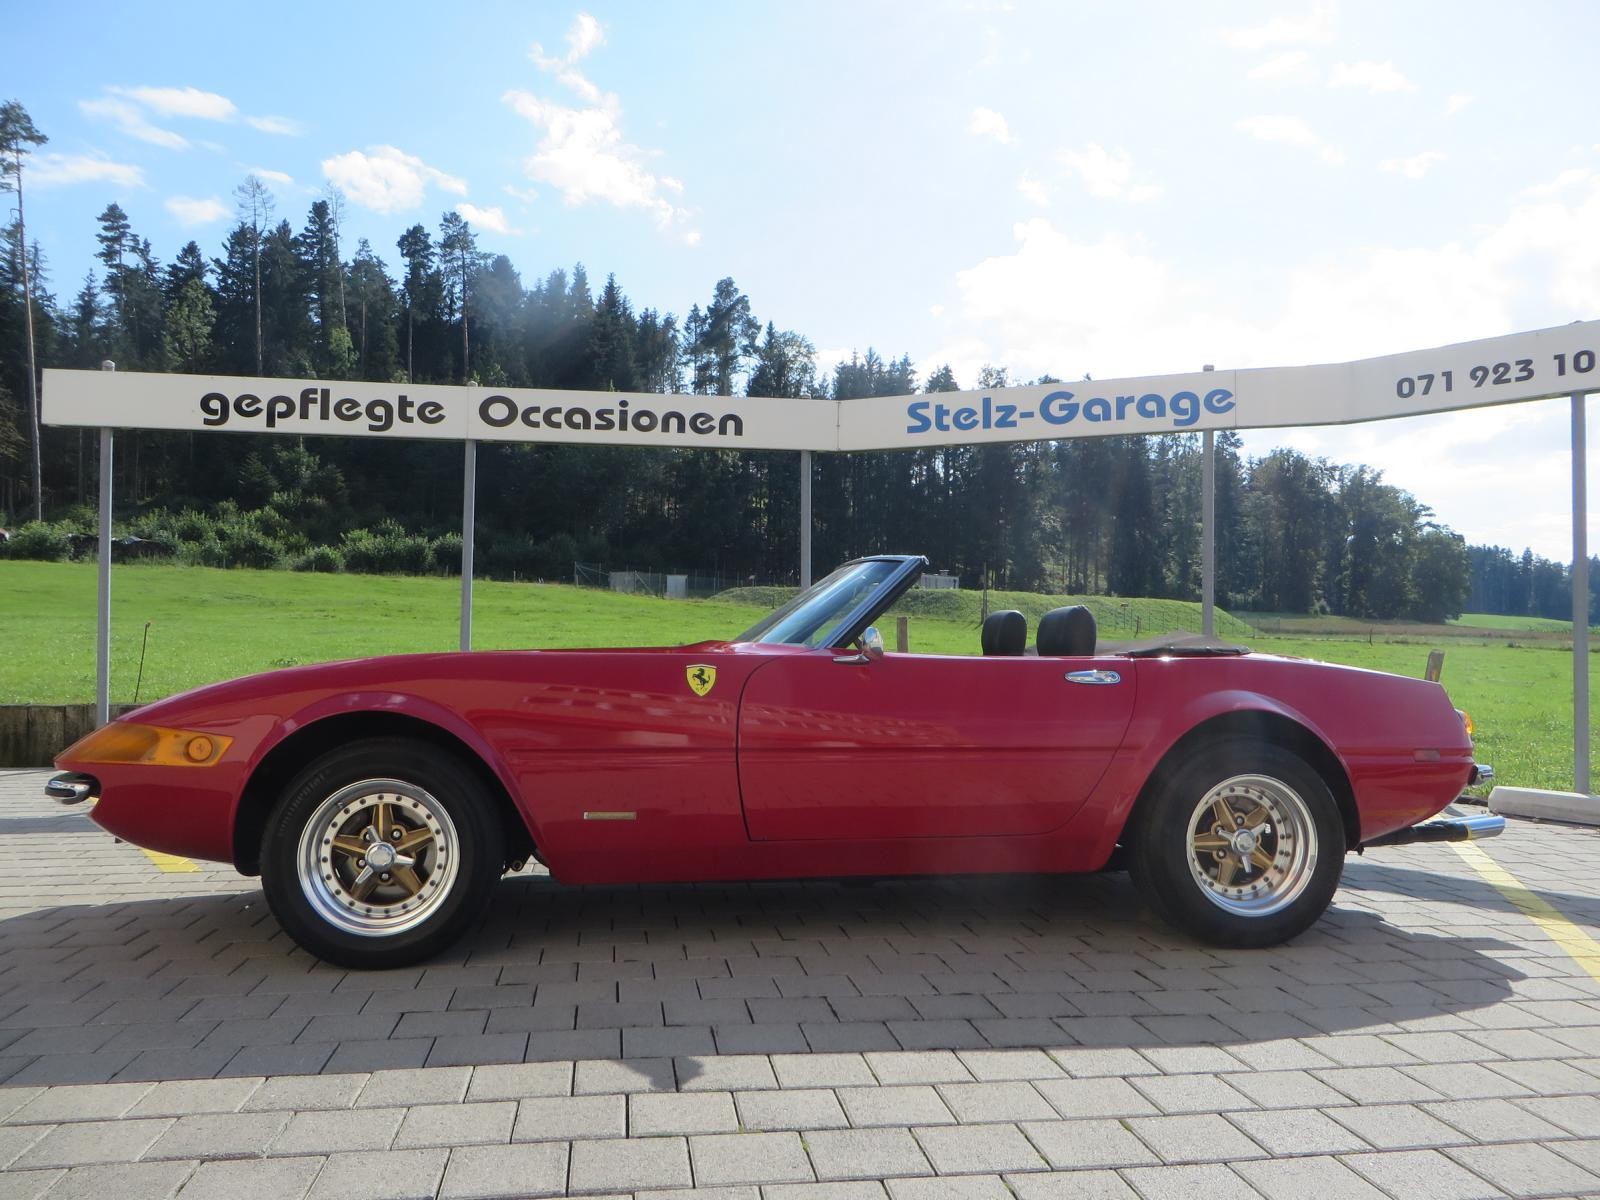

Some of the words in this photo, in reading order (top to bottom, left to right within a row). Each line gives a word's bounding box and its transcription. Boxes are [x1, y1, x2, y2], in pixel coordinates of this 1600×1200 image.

[1396, 371, 1453, 398] 071
[1469, 359, 1535, 388] 923
[1553, 350, 1596, 376] 10
[200, 387, 446, 432] gepflegte
[478, 395, 743, 436] Occasionen
[907, 388, 1236, 434] Stelz-Garage
